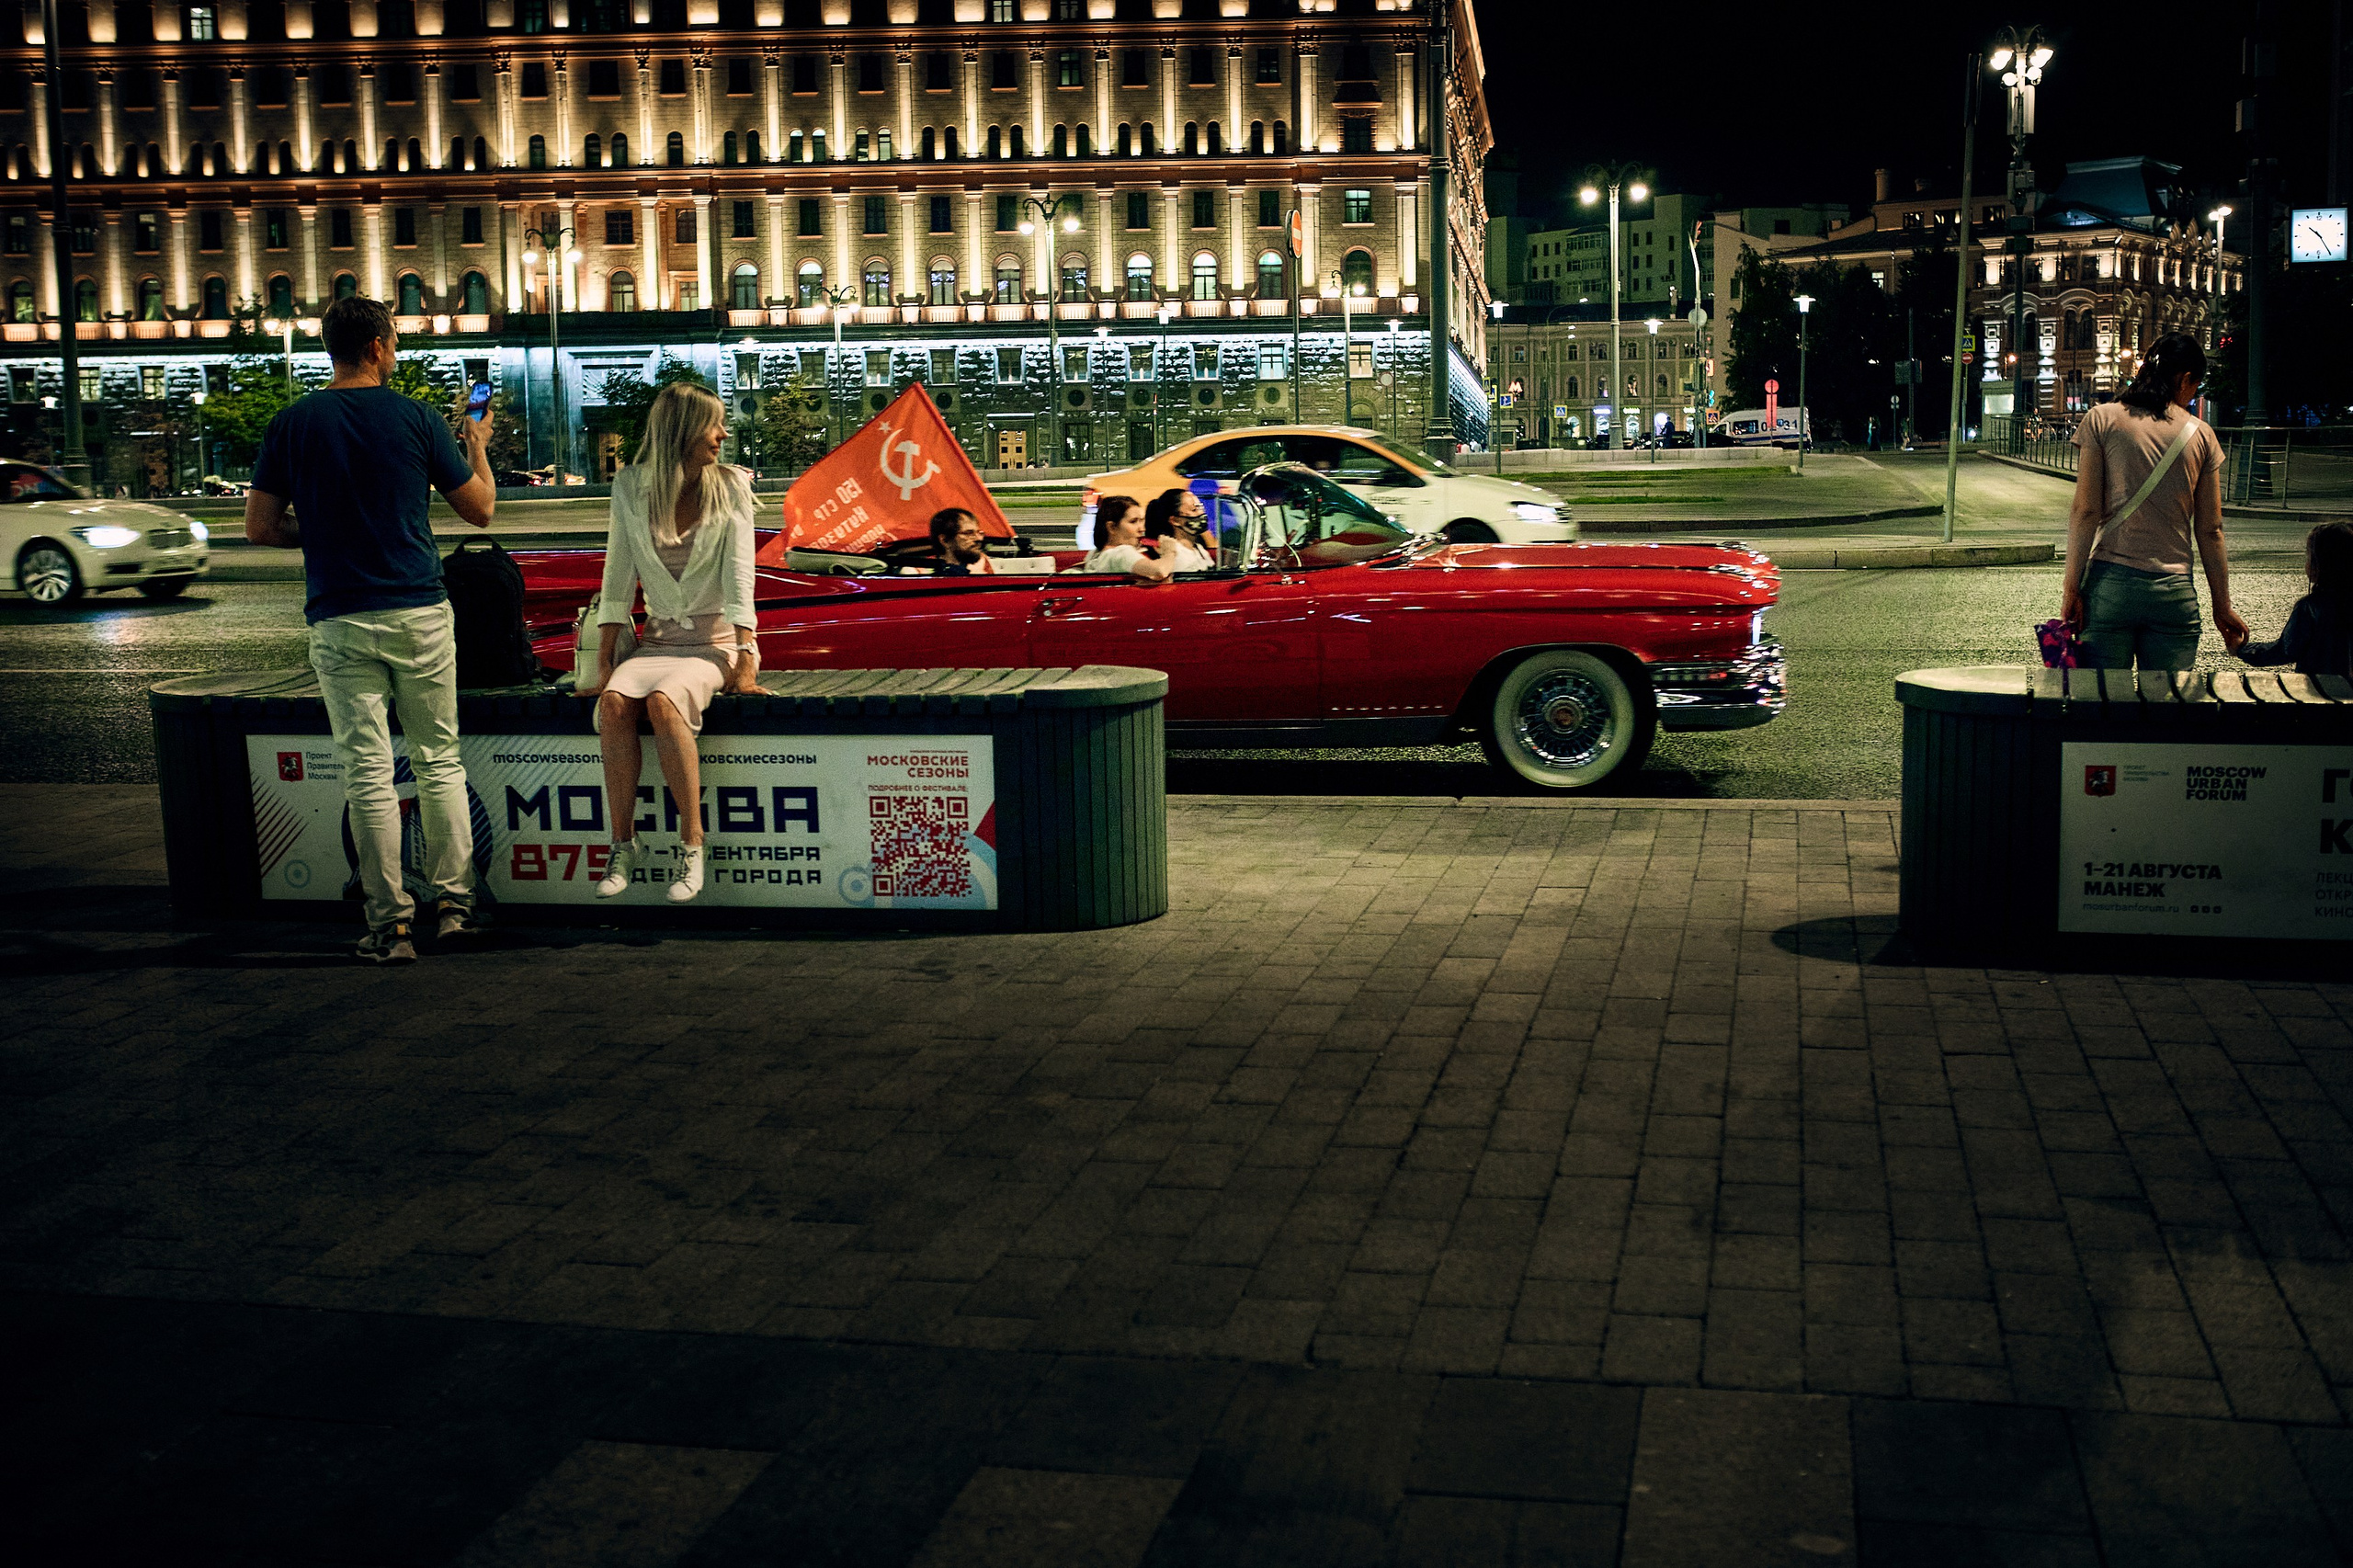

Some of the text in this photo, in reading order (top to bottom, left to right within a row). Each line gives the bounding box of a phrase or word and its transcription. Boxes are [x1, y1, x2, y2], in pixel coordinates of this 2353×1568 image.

[305, 751, 332, 760] Проект
[700, 754, 817, 764] ковскиесезоны
[867, 756, 969, 766] МОСКОВСКИЕ
[306, 762, 346, 770] Правитель
[2186, 766, 2268, 778] MOSCOW
[308, 772, 337, 780] Москвы
[907, 767, 969, 778] СЕЗОНЫ
[2186, 778, 2248, 790] URBAN
[2322, 768, 2353, 803] Г
[2185, 789, 2247, 801] FORUM
[708, 846, 821, 861] ЕНТЯБРЯ
[511, 844, 611, 881] 875
[715, 869, 821, 885] ГОРОДА
[2128, 864, 2222, 880] АВГУСТА
[2083, 881, 2166, 898] МАНЕЖ
[2082, 902, 2180, 914] mosurbanforum.ru
